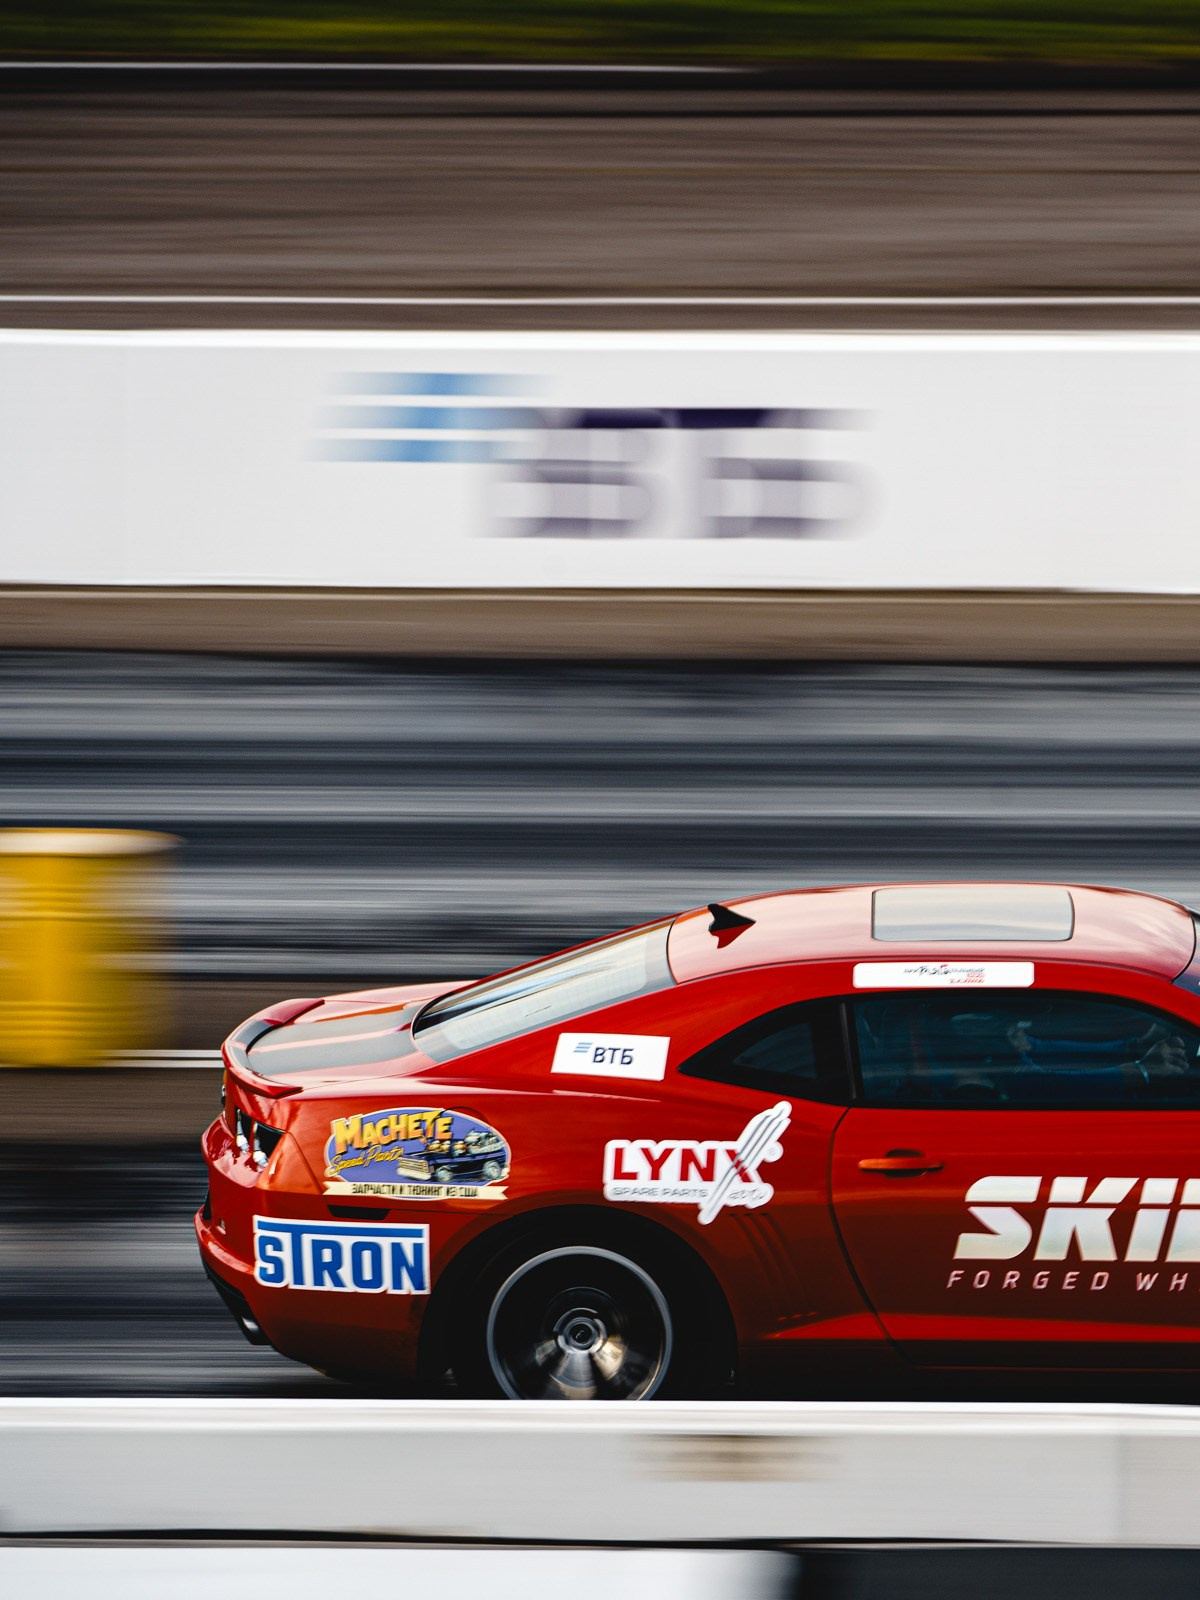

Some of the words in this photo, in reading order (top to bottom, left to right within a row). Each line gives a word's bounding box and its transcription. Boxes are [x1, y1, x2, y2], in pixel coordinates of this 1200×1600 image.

[592, 1046, 634, 1066] ВТБ
[334, 1109, 453, 1156] MACHETE
[613, 1147, 758, 1183] LYNX
[257, 1220, 426, 1290] STRON
[946, 1270, 1110, 1291] FORGED
